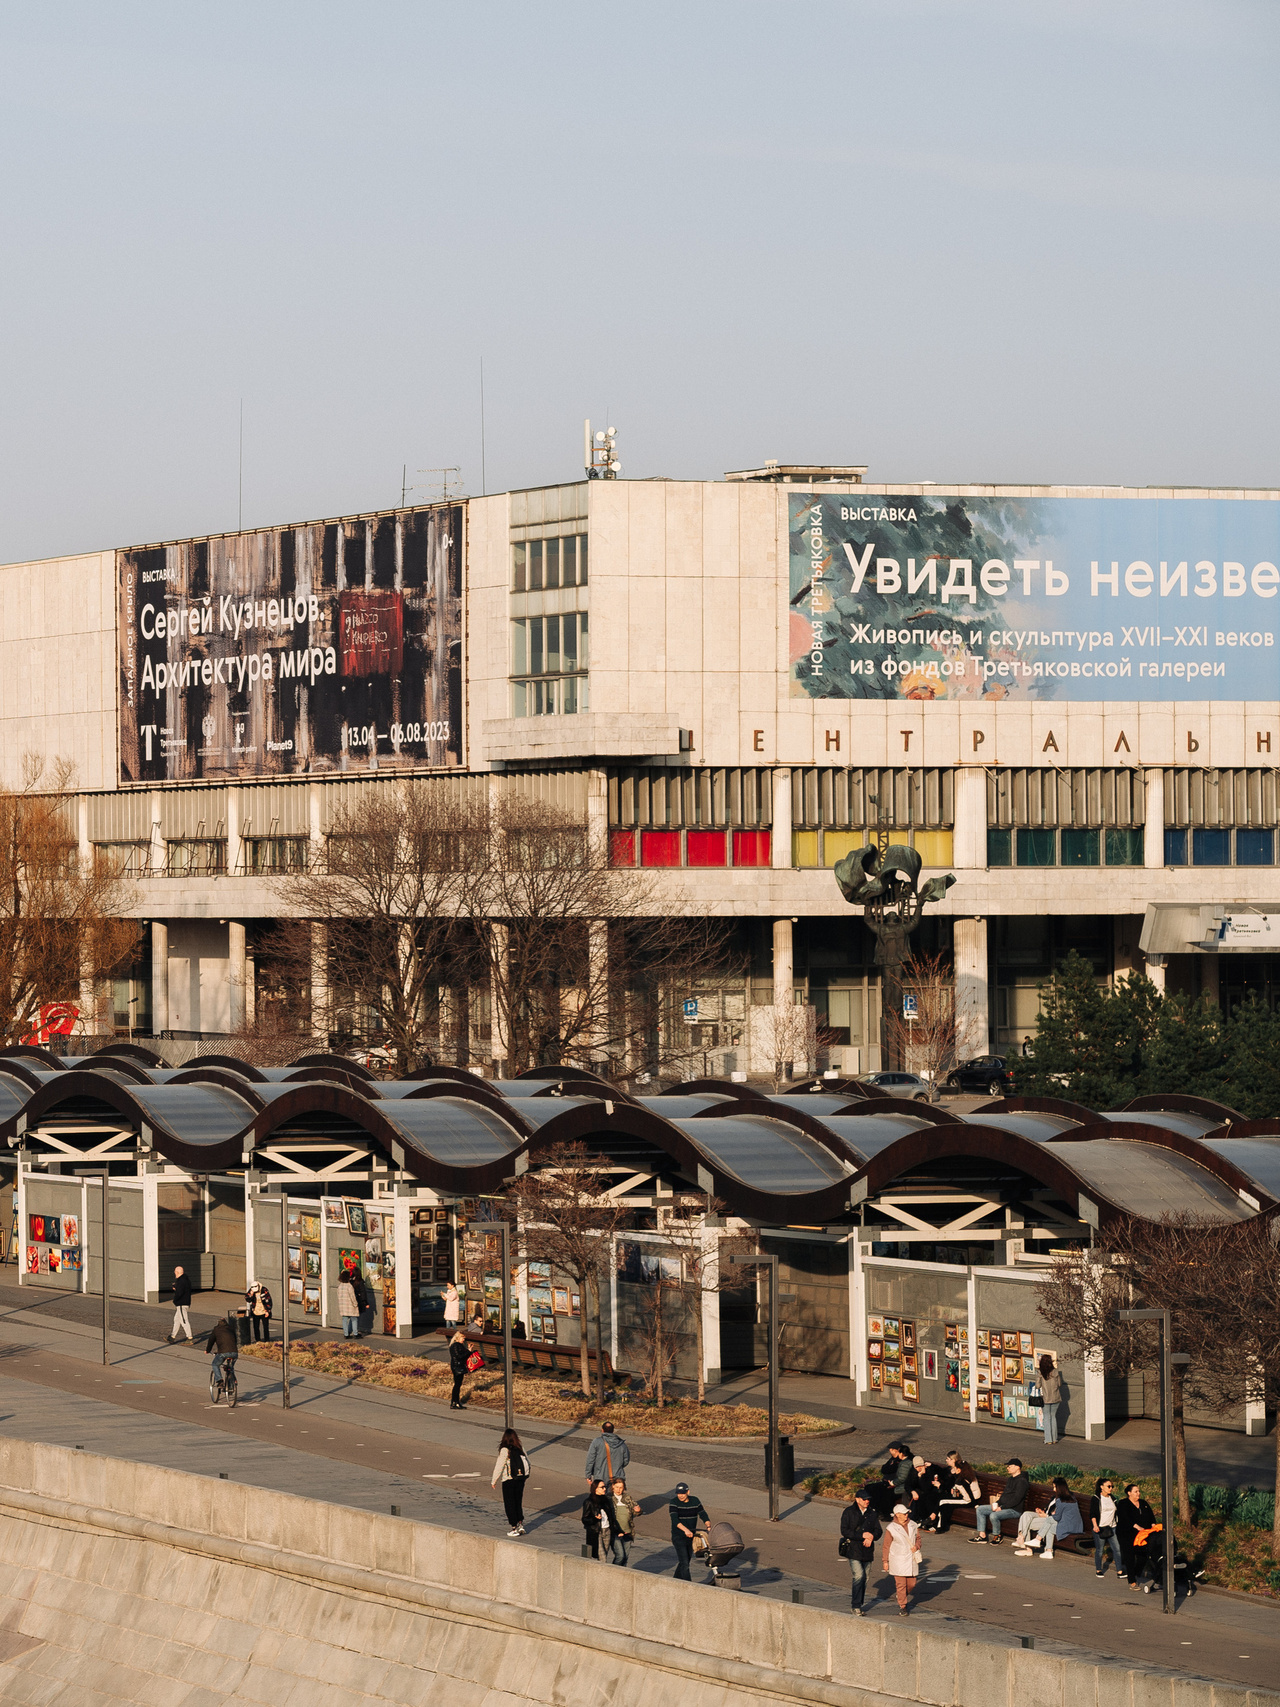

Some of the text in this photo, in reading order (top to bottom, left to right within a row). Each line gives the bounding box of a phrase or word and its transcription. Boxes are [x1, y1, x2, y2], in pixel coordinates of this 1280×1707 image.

[840, 506, 918, 521] ВЫСТАВКА
[442, 533, 454, 549] 0+
[142, 567, 176, 583] ВЫСТАВКА
[842, 543, 1280, 603] Увидеть неизве
[810, 504, 824, 676] НОВАЯ ТРЕТЬЯКОВКА
[140, 595, 214, 647] Сергей
[219, 594, 325, 640] Кузнецов.
[849, 623, 963, 646] Живопись
[970, 629, 983, 646] и
[989, 630, 1114, 650] скульптура
[1214, 630, 1275, 647] веков
[140, 646, 337, 699] Архитектура мира
[850, 654, 1226, 683] из фондов Третьяковской галереи
[267, 740, 293, 751] Planet9
[348, 725, 375, 747] 13.04
[390, 721, 450, 744] 06.08.2023
